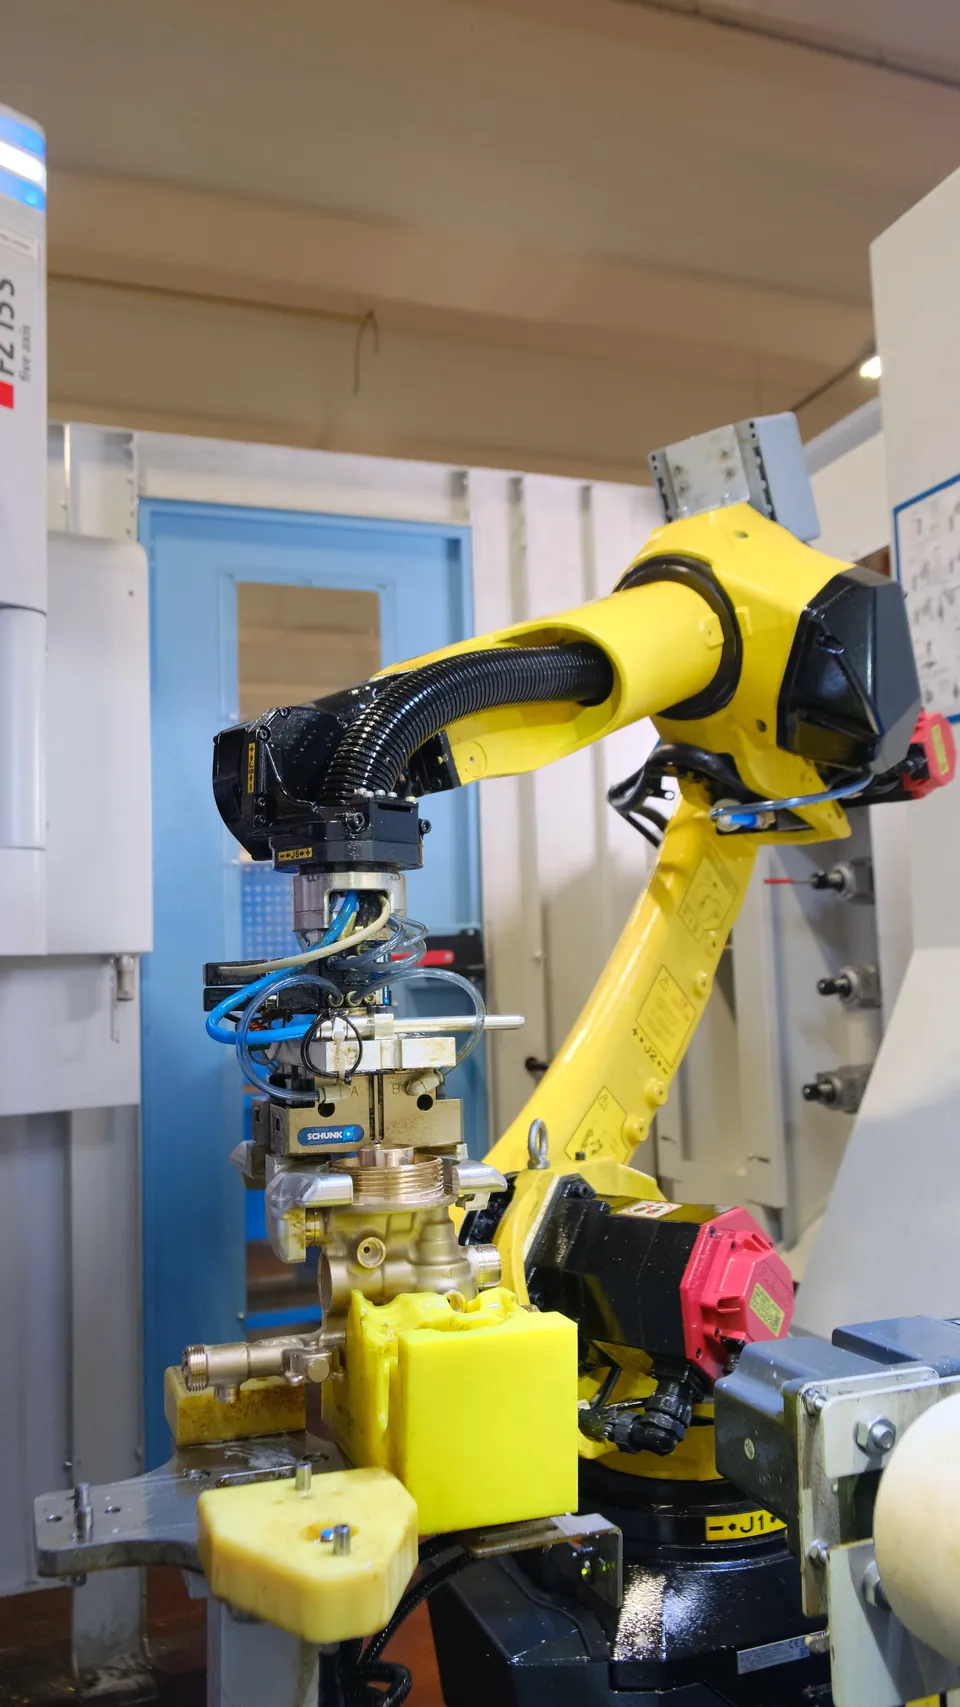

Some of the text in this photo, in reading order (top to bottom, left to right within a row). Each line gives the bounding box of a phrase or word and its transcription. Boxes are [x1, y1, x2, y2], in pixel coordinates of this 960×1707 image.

[350, 1086, 360, 1097] A
[392, 1083, 401, 1095] B
[307, 1131, 343, 1141] SCHUNK
